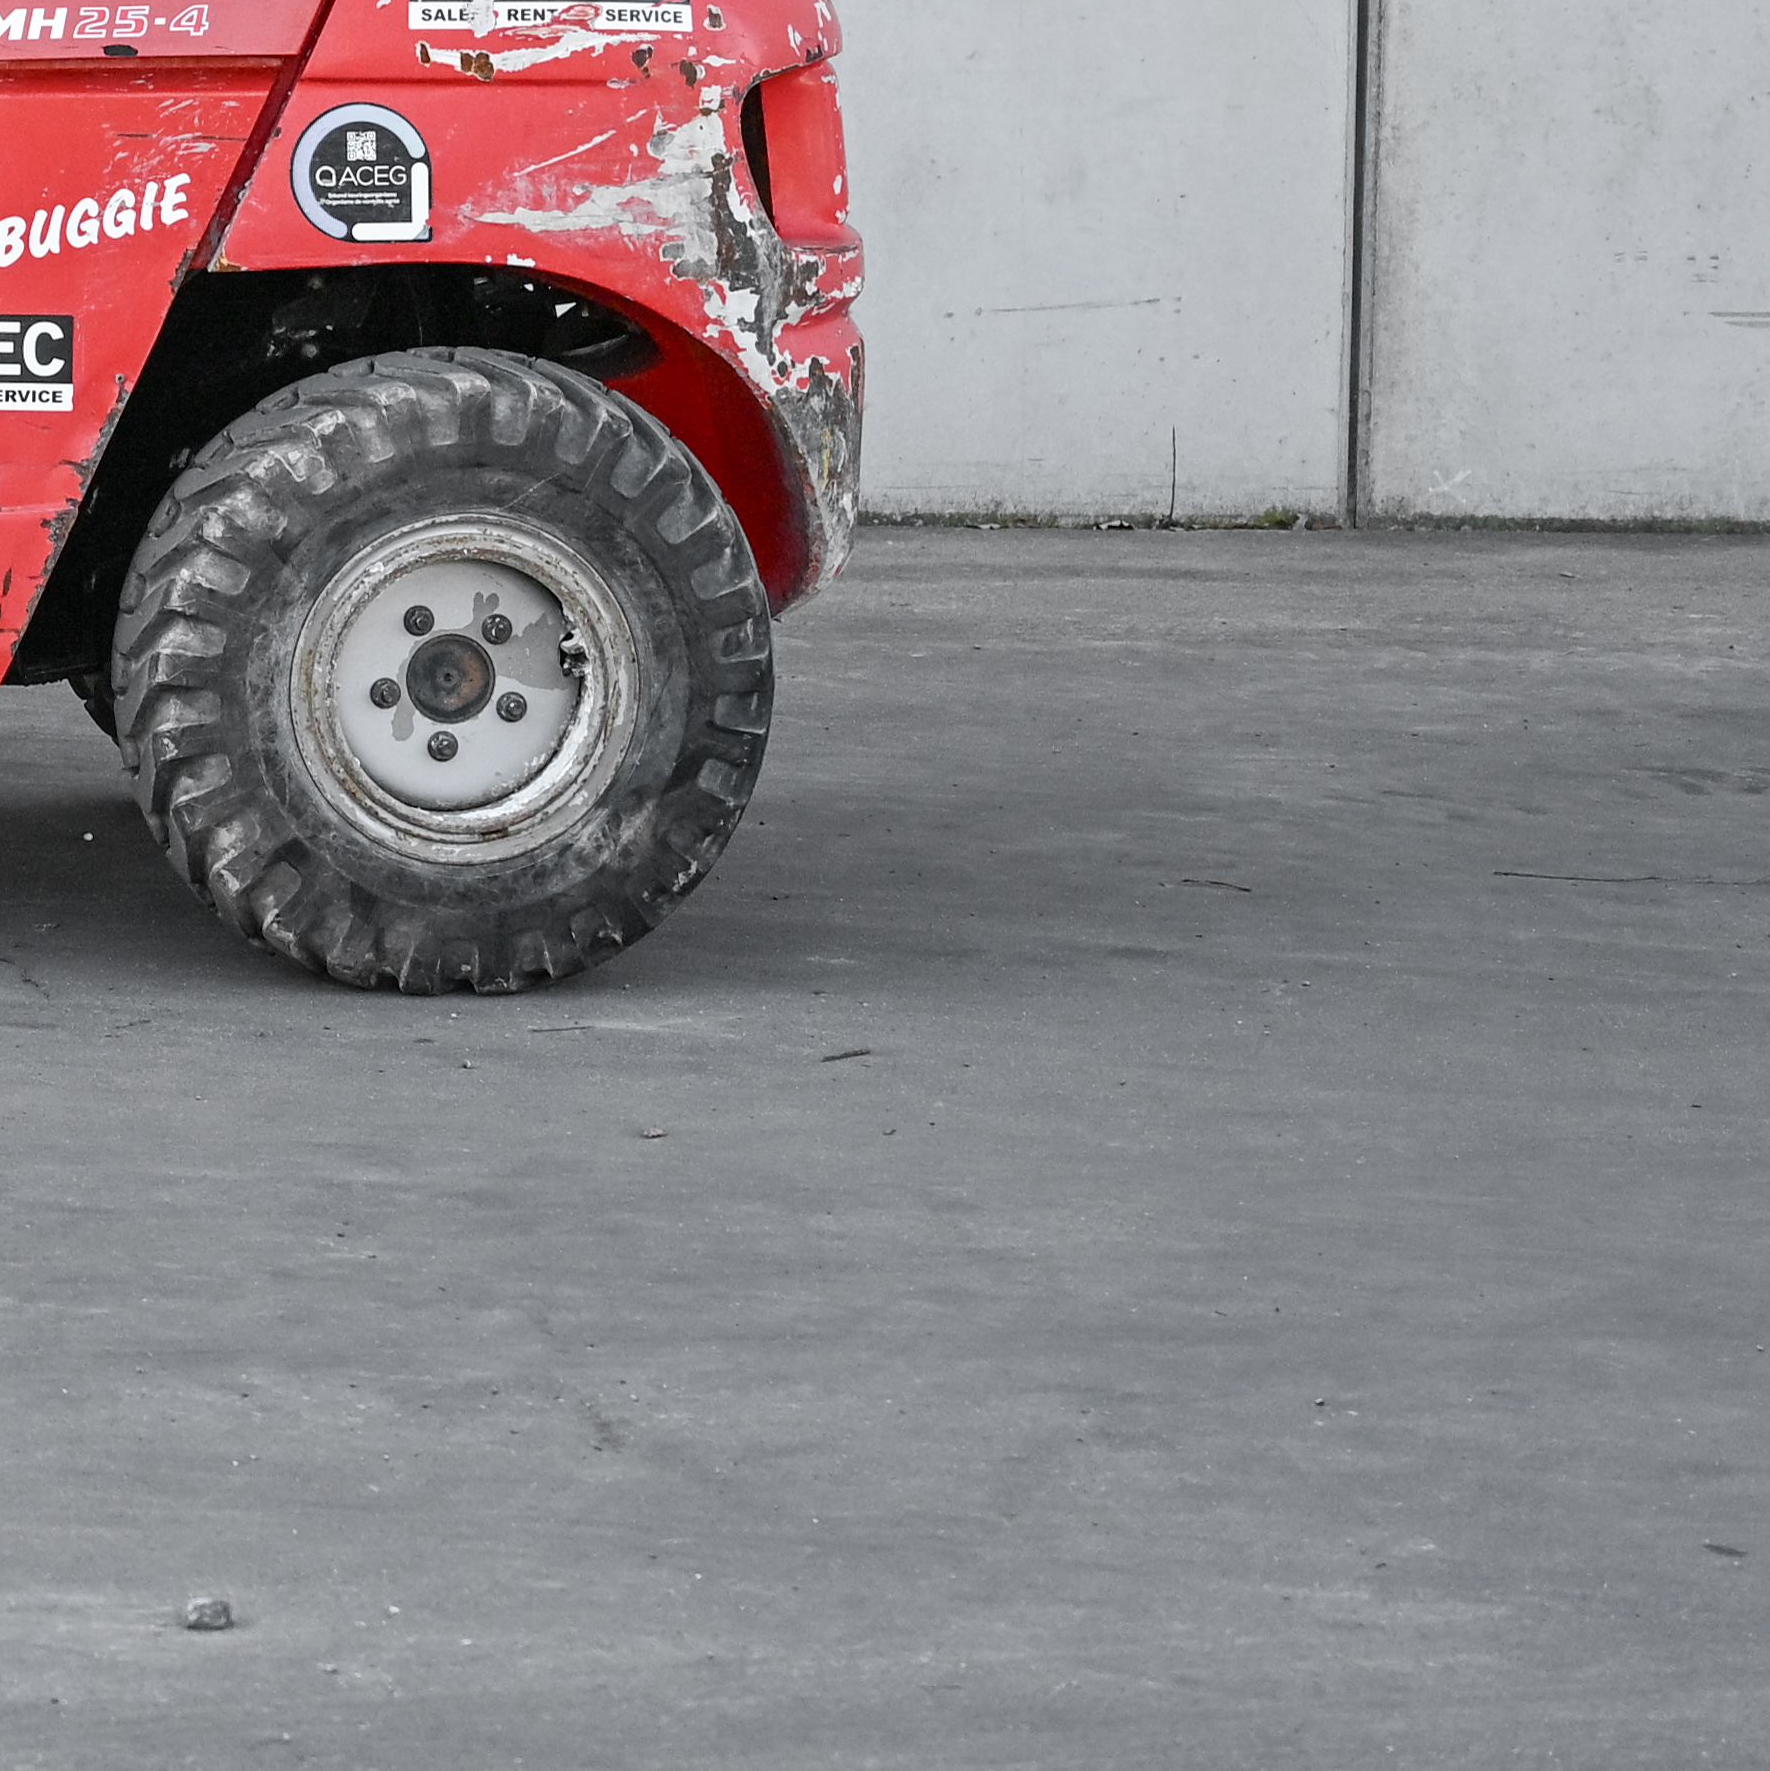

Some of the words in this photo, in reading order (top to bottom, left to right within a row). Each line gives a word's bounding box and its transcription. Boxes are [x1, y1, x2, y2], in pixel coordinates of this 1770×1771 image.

[421, 8, 475, 22] SALE
[507, 8, 561, 21] RENT
[605, 8, 684, 24] SERVICE
